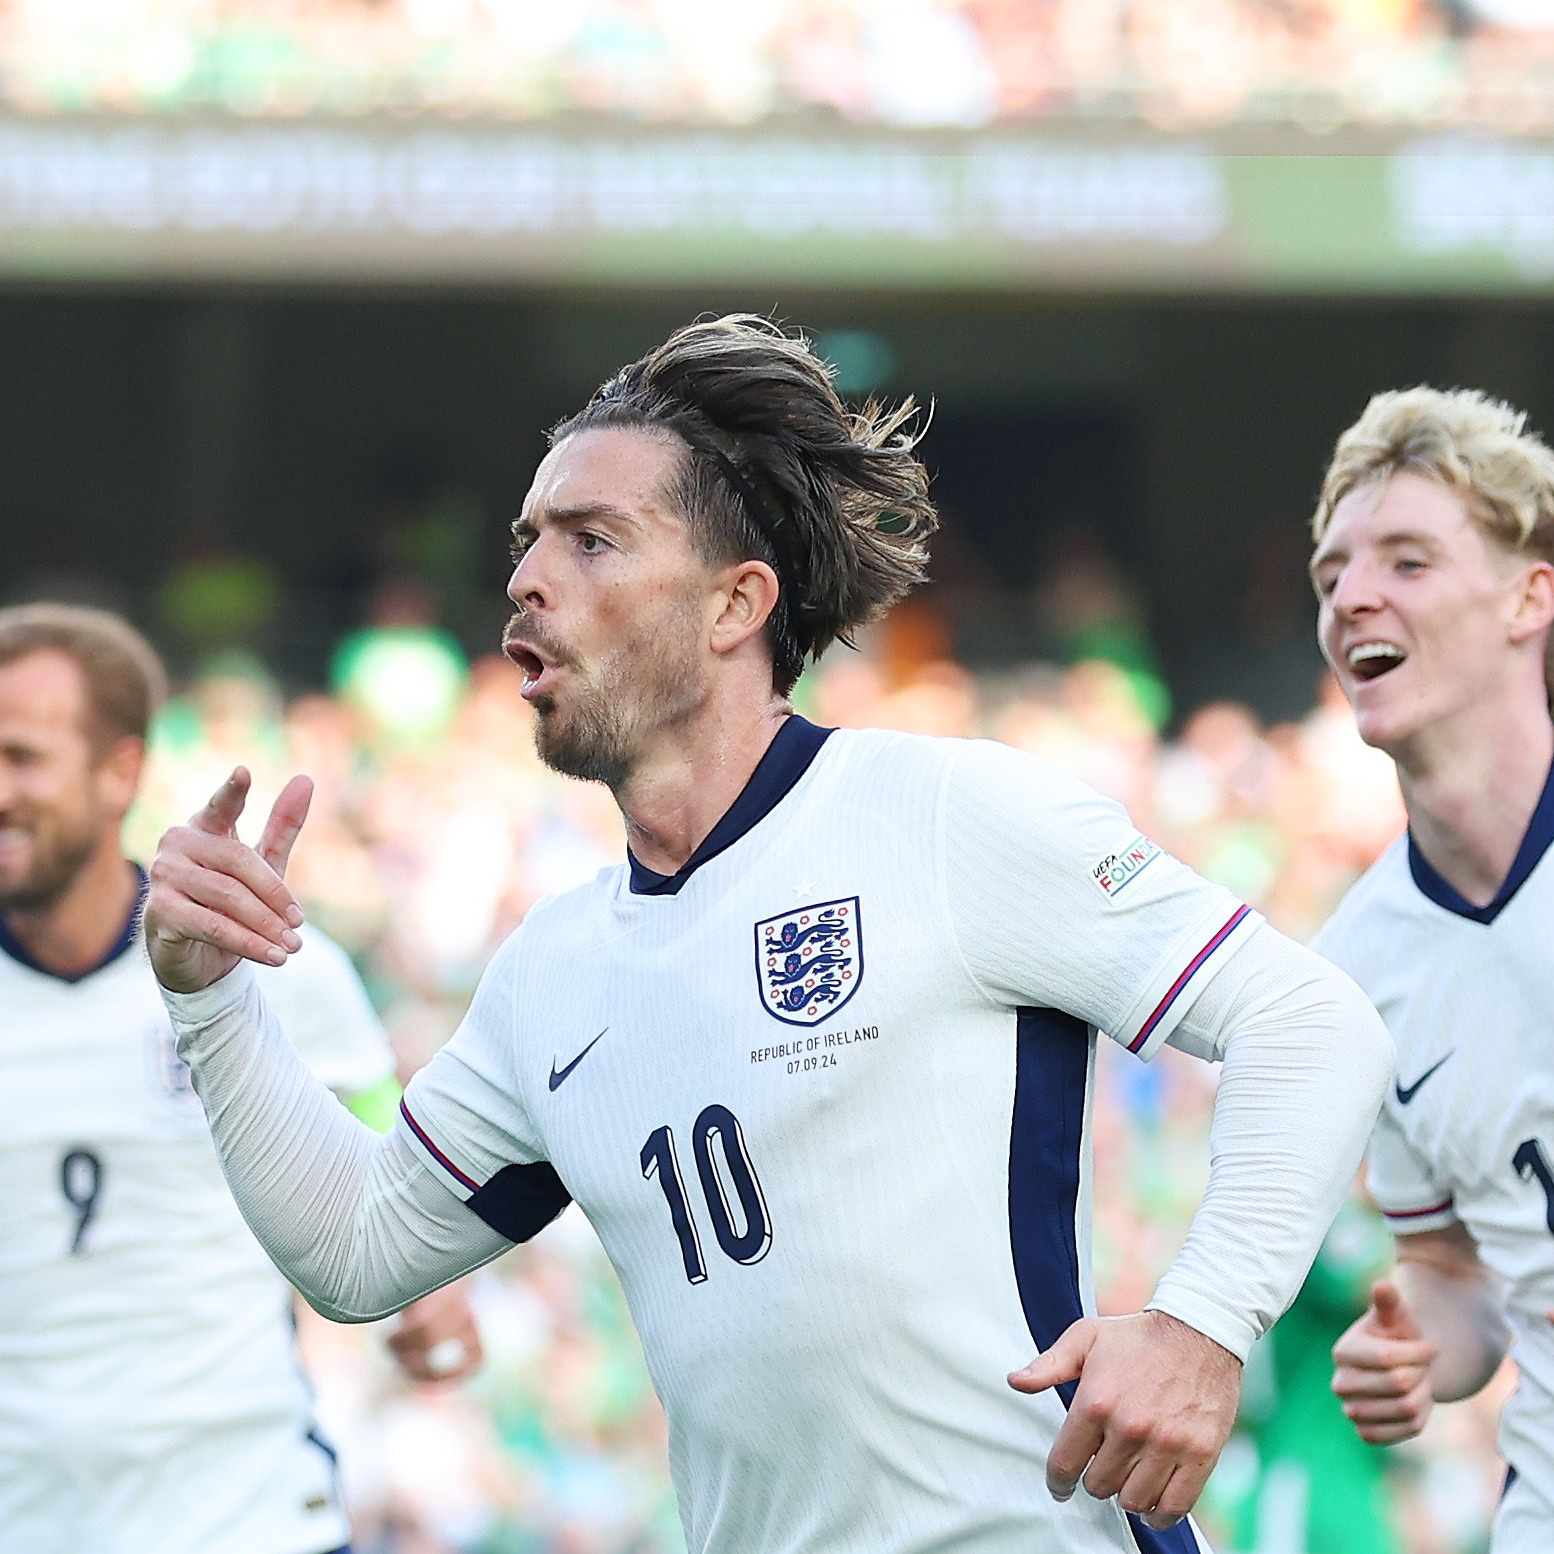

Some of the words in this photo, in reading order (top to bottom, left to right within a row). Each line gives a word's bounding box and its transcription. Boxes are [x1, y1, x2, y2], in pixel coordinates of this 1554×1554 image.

[1092, 854, 1119, 878] UEFA
[750, 1040, 803, 1064] REPUBLIC
[806, 1037, 820, 1051] OF
[824, 1026, 879, 1047] IRELAND
[787, 1053, 837, 1074] 07.09.24
[59, 1147, 104, 1256] 9
[639, 1104, 774, 1285] 10
